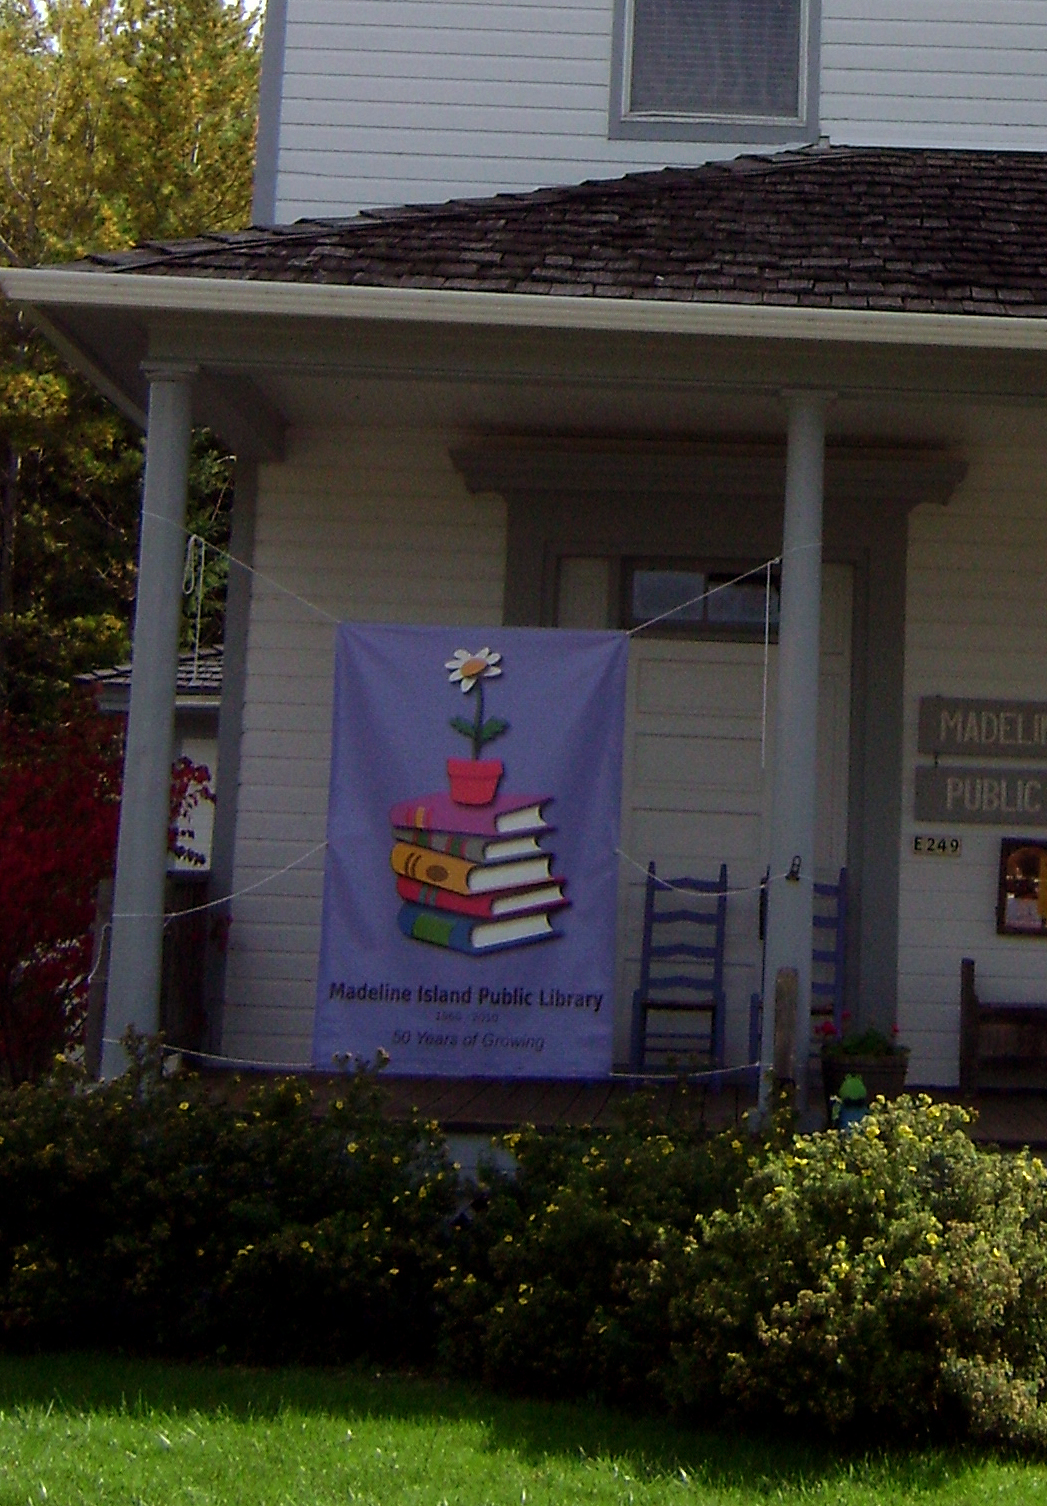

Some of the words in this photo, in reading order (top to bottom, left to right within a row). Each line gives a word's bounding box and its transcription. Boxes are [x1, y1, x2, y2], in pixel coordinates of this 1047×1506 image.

[945, 777, 1042, 813] PUBLIC
[913, 836, 960, 854] E249
[328, 982, 412, 1003] Madeline
[417, 985, 471, 1005] Island
[478, 987, 533, 1007] Public
[539, 988, 604, 1012] Library
[392, 1029, 411, 1046] 50
[416, 1030, 458, 1047] Years
[463, 1031, 477, 1048] of
[483, 1032, 545, 1052] Growing
